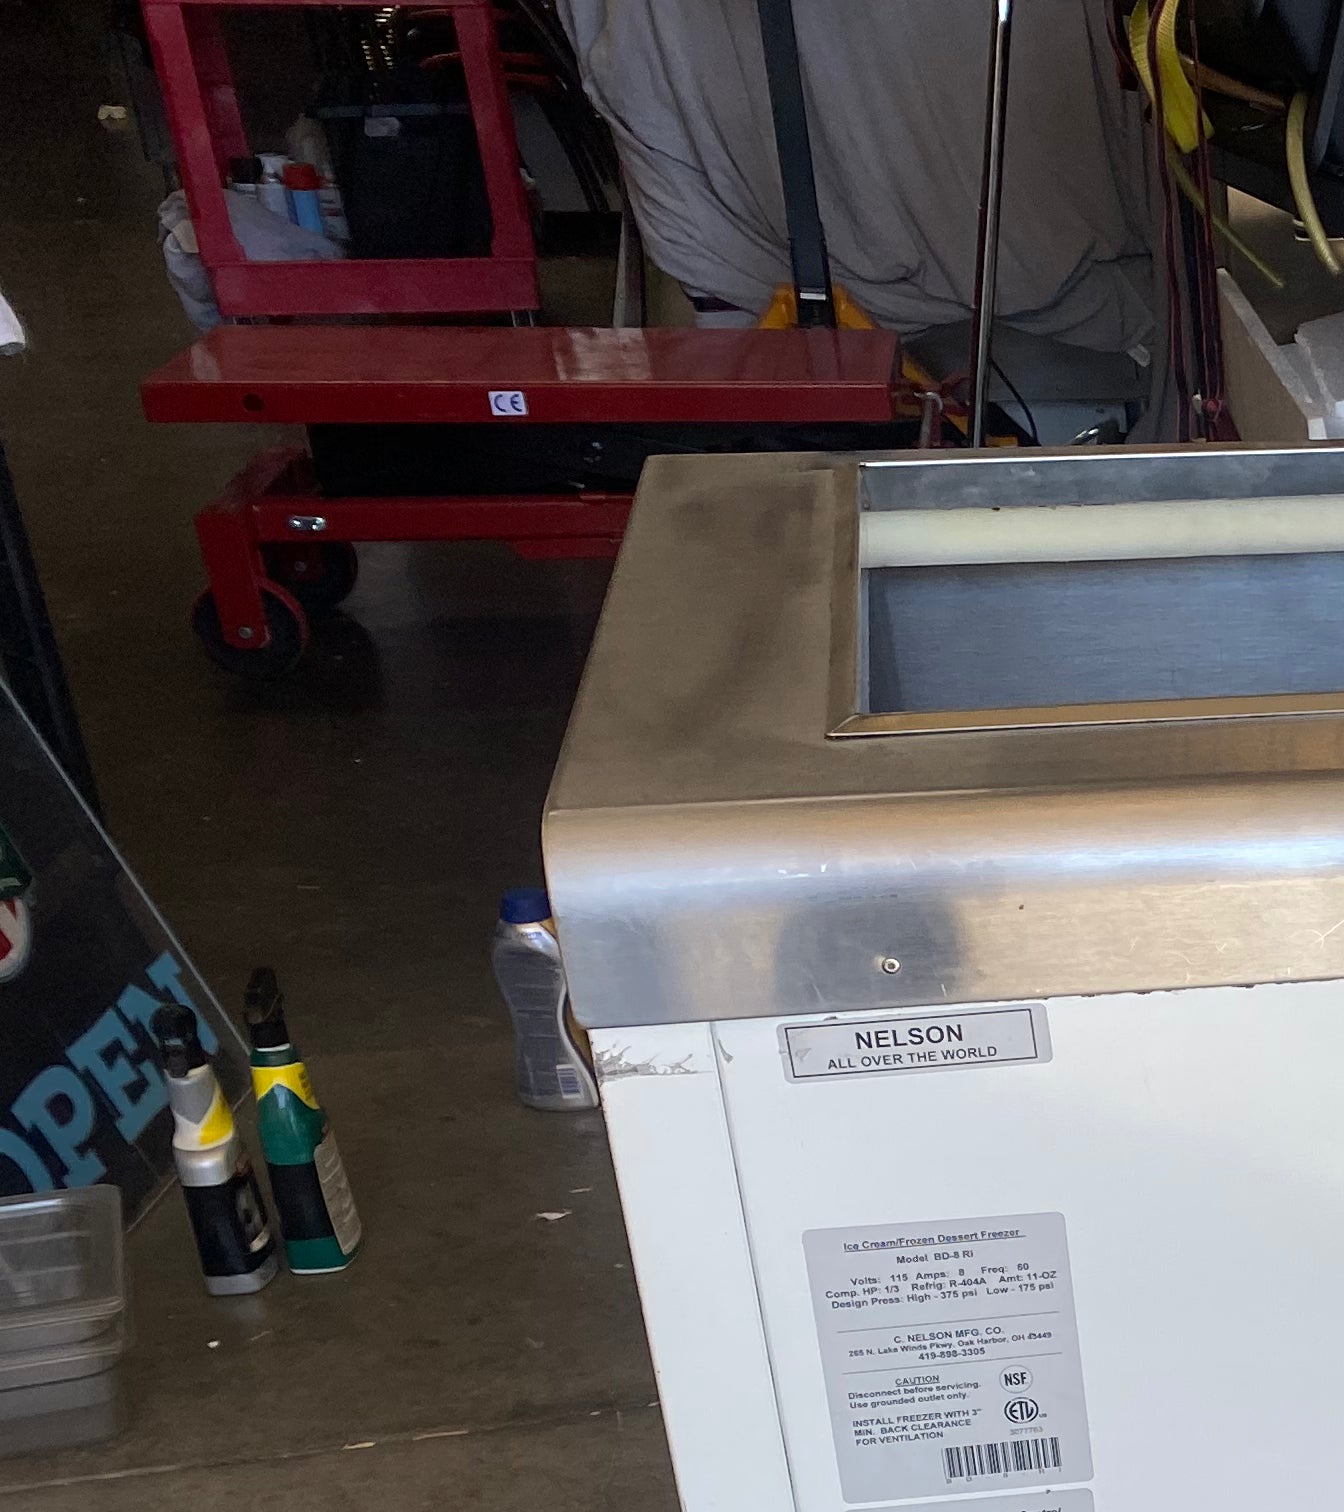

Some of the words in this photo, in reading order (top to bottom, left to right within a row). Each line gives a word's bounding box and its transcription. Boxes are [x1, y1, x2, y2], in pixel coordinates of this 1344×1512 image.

[494, 394, 523, 412] CE
[854, 1023, 963, 1050] NELSON
[826, 1057, 856, 1070] ALL
[860, 1053, 903, 1067] OVER
[907, 1050, 937, 1063] THE
[940, 1046, 998, 1061] WORLD
[843, 1241, 859, 1251] Ice
[861, 1235, 934, 1250] Cream/Frozen
[937, 1230, 978, 1243] Dessert
[980, 1227, 1020, 1239] Freezer
[896, 1253, 928, 1264] Model
[933, 1250, 959, 1261] BD-8
[850, 1275, 880, 1286] Volts:
[889, 1273, 908, 1283] 115
[915, 1269, 949, 1282] Amps:
[957, 1267, 965, 1276] 8
[980, 1263, 1007, 1276] Freq:
[825, 1288, 859, 1300] Comp.
[862, 1286, 881, 1296] HP:
[884, 1284, 899, 1294] 1/3
[911, 1280, 946, 1292] Refrig:
[948, 1276, 986, 1288] R-404A
[997, 1273, 1023, 1283] Amt:
[831, 1298, 868, 1310] Design
[870, 1295, 903, 1306] Press:
[906, 1292, 930, 1303] High
[940, 1290, 958, 1300] 375
[961, 1288, 977, 1298] psi
[986, 1285, 1008, 1295] Low
[1018, 1283, 1036, 1292] 175
[1037, 1281, 1054, 1291] psi
[907, 1330, 952, 1343] NELSON
[895, 1374, 940, 1386] CAUTION
[1004, 1371, 1027, 1386] NSF
[848, 1387, 901, 1400] Disconnect
[903, 1384, 933, 1394] before
[935, 1379, 981, 1392] servicing.
[849, 1401, 868, 1409] Use
[870, 1396, 915, 1408] grounded
[917, 1393, 944, 1403] outlet
[946, 1390, 969, 1401] only.
[852, 1416, 894, 1428] INSTALL
[896, 1412, 941, 1423] FREEZER
[943, 1409, 969, 1418] WITH
[1009, 1400, 1034, 1422] ETL
[854, 1427, 875, 1437] MIN.
[880, 1424, 908, 1434] BACK
[910, 1418, 971, 1431] CLEARANCE
[855, 1437, 876, 1446] FOR
[879, 1430, 943, 1444] VENTILATION
